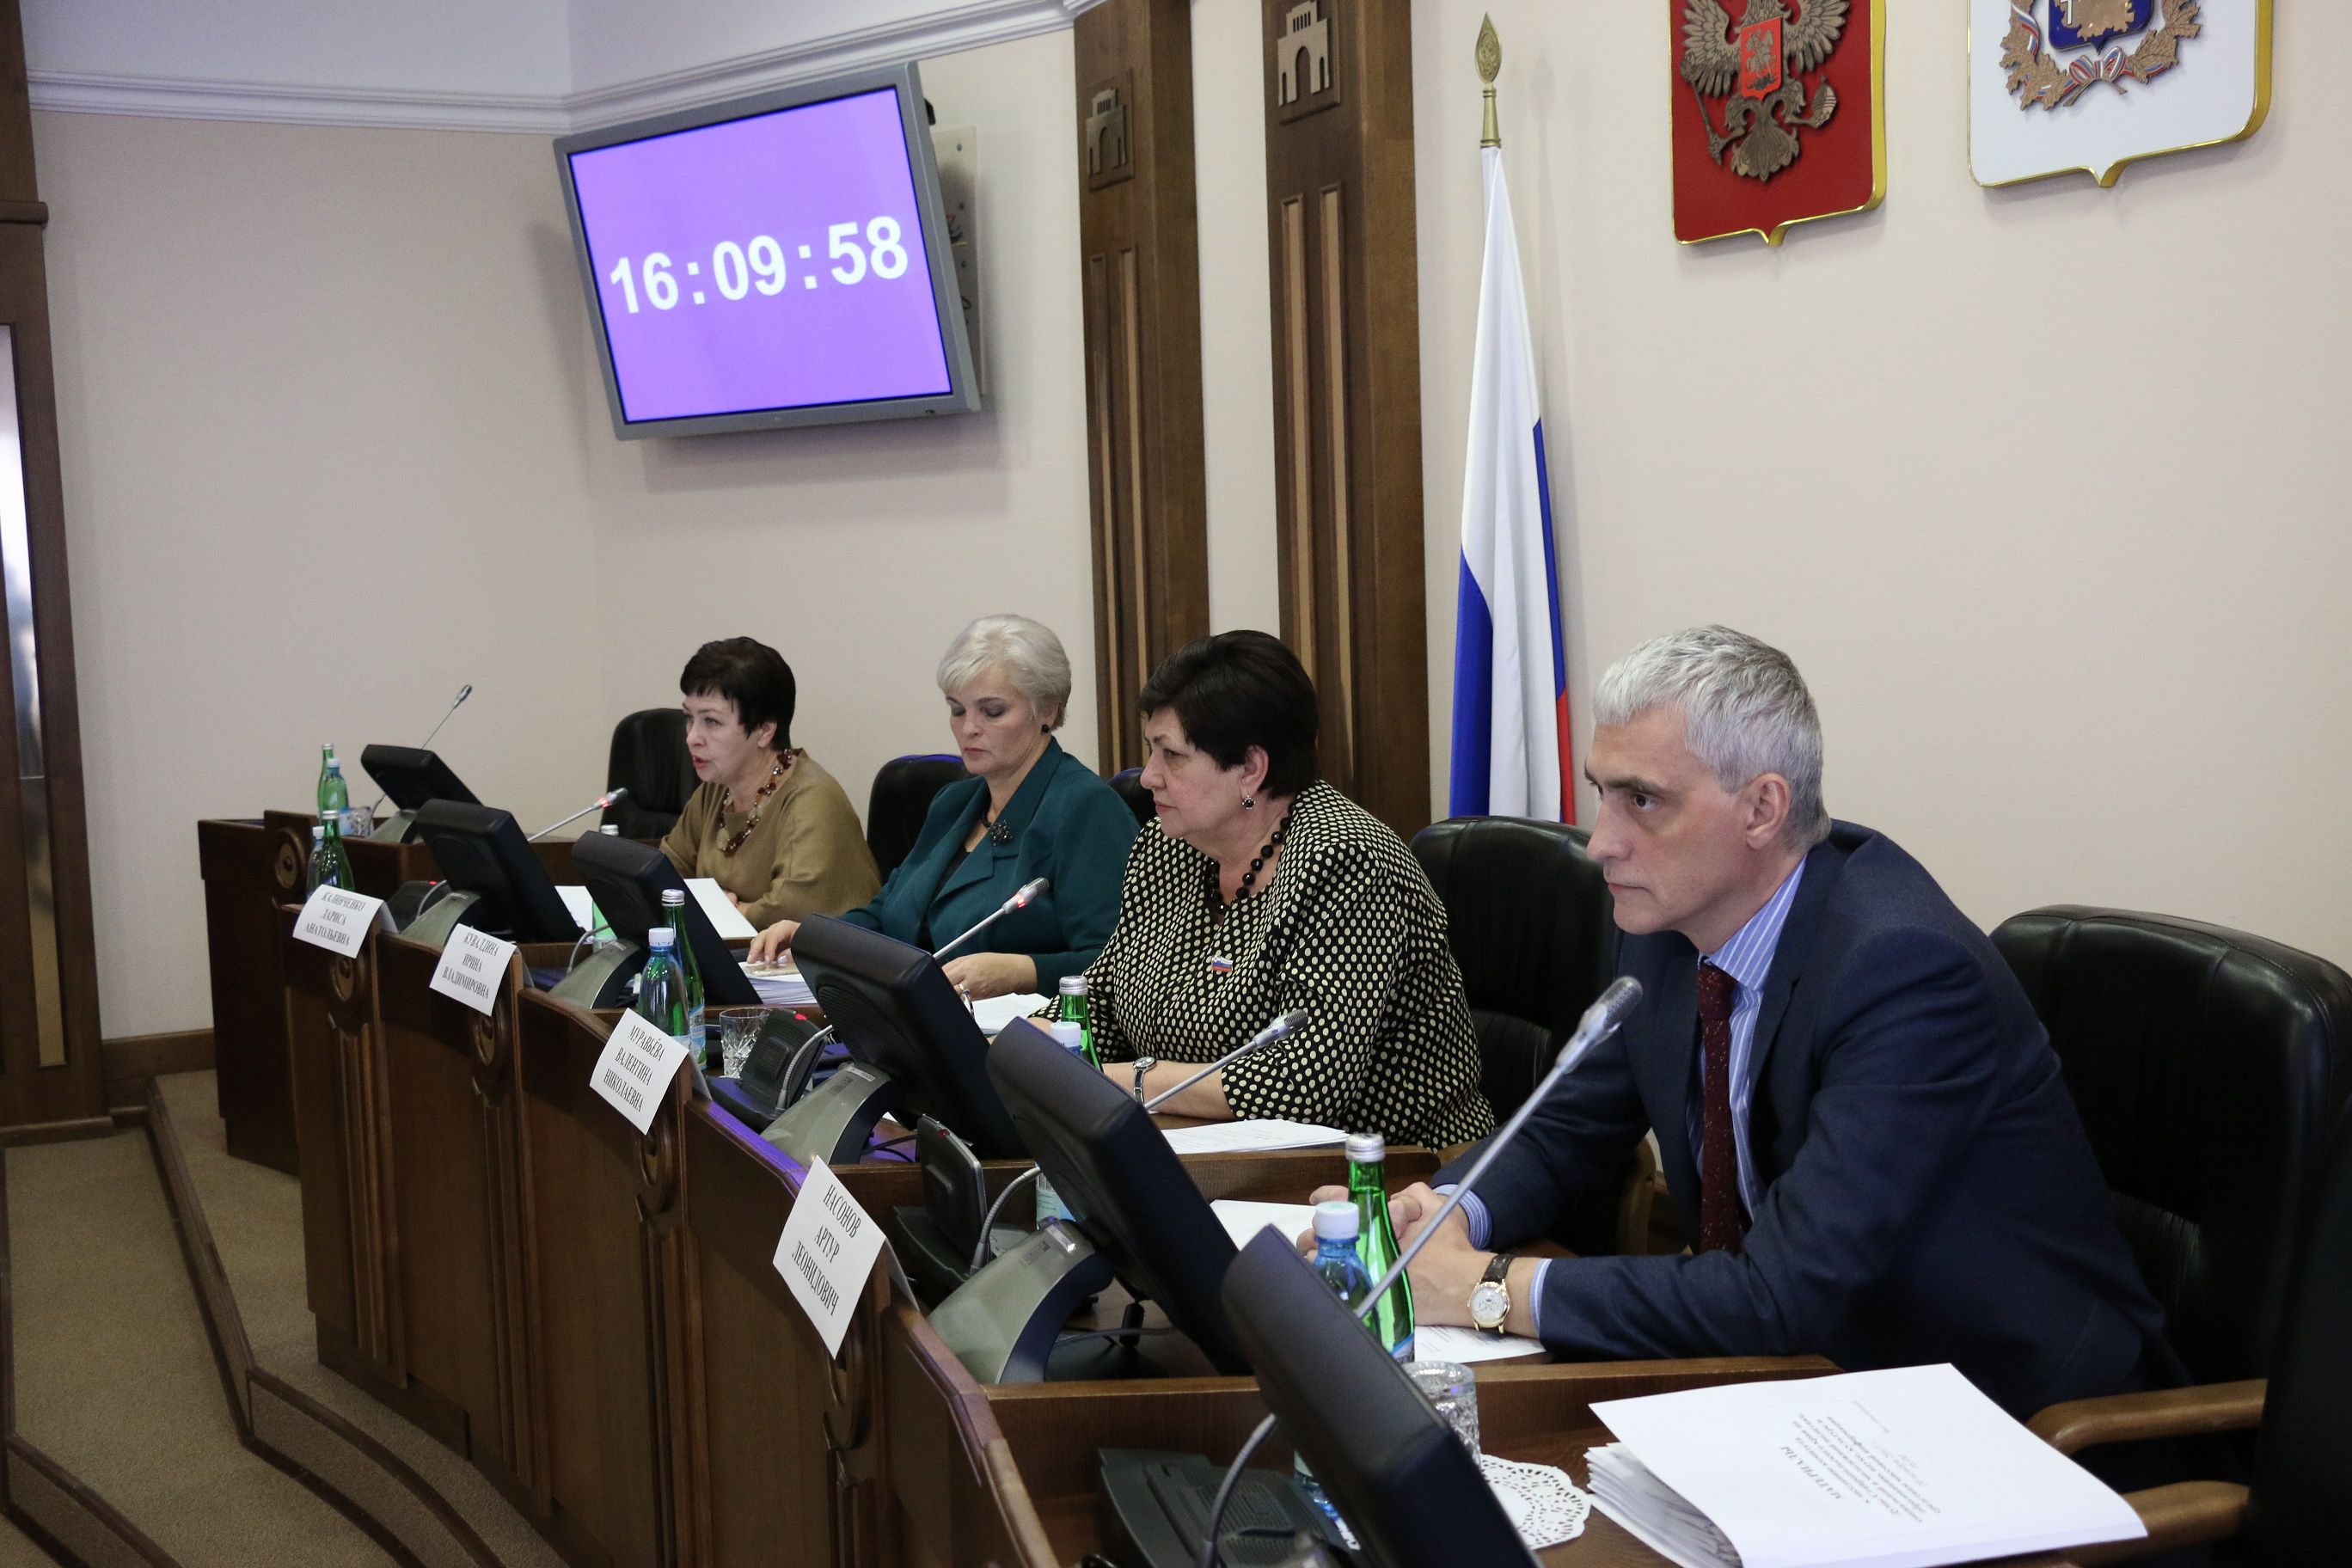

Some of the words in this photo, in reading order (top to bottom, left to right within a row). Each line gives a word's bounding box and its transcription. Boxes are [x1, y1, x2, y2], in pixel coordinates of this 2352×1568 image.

[609, 216, 909, 315] 16:09:58
[305, 922, 351, 946] АНАТОЛЬЕВНА
[320, 909, 346, 926] ЛАРИСА
[462, 953, 483, 972] ИРИНА
[463, 932, 499, 956] КУВАЛДИНА
[442, 966, 489, 999] ВЛАДИМИРОВНА
[628, 1025, 665, 1062] МУРАВЬЁВА
[615, 1047, 653, 1086] ВАЛЕНТИНА
[603, 1068, 644, 1112] НИКОЛАЕВНА
[823, 1184, 861, 1239] НАСОНОВ
[814, 1224, 840, 1264] АРТУР
[792, 1240, 839, 1316] ЛЕОНИДОВИЧ
[1780, 1445, 1841, 1499] МАТЕРИАЛЫ
